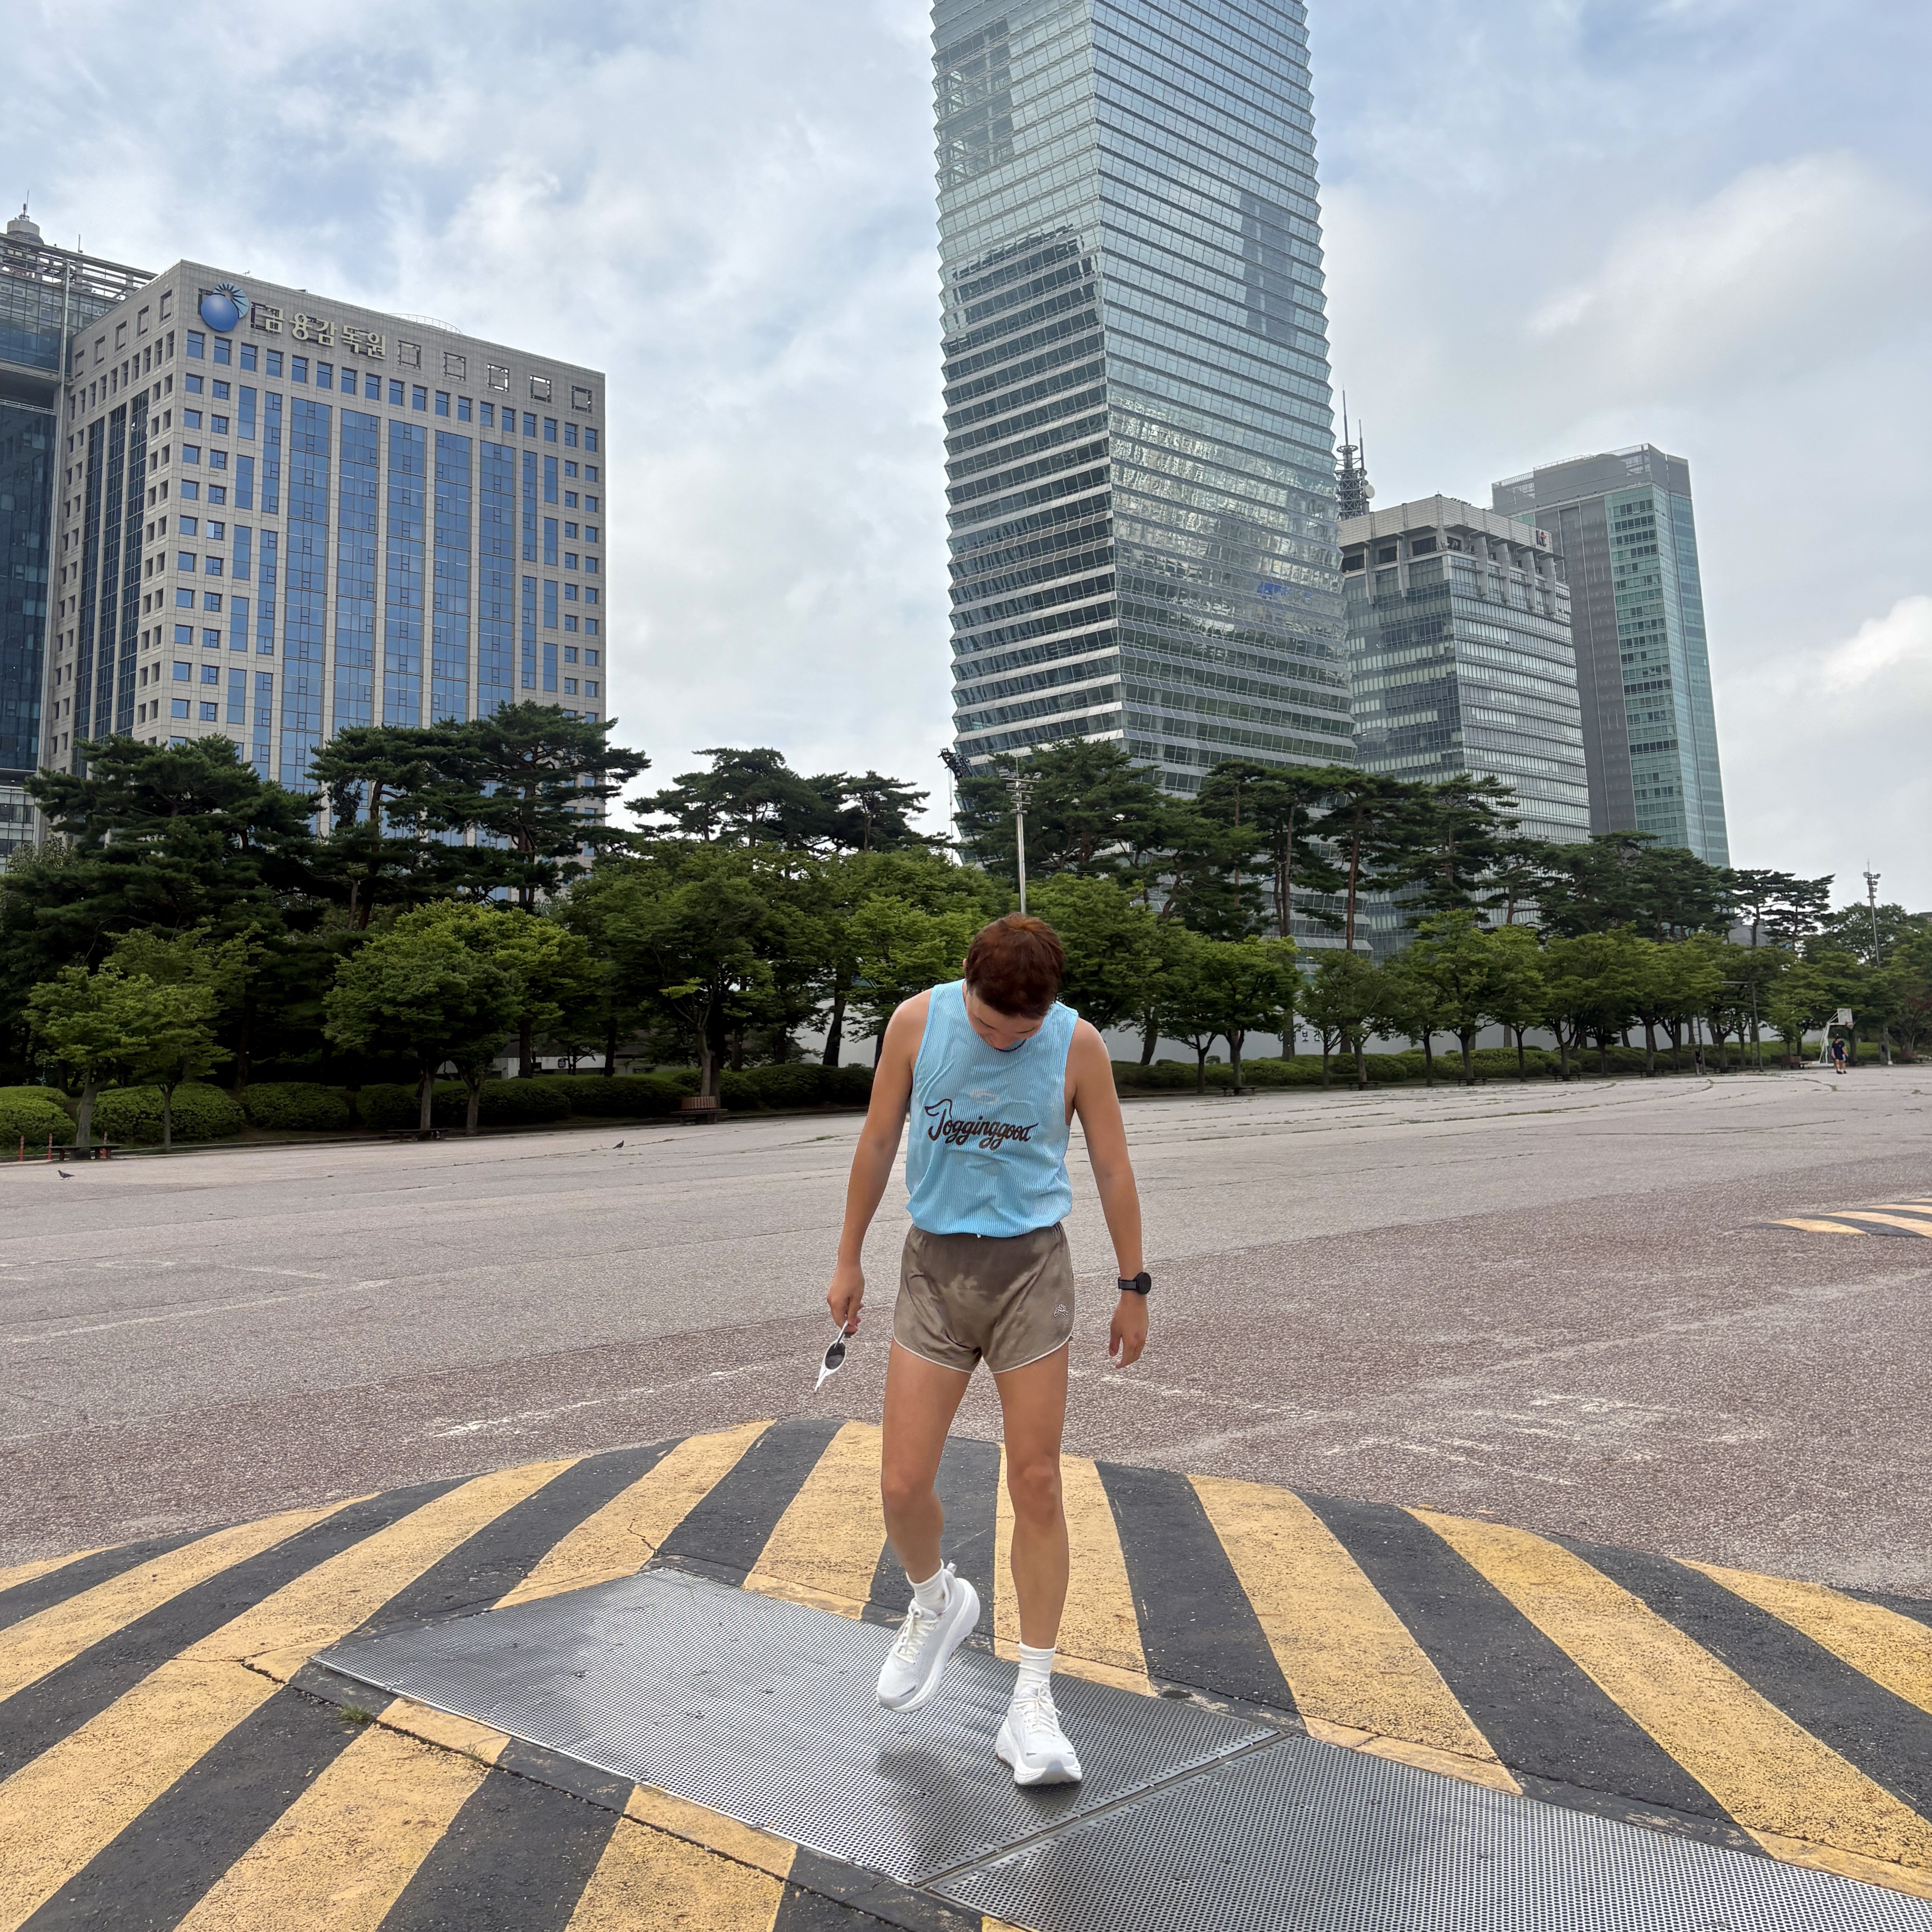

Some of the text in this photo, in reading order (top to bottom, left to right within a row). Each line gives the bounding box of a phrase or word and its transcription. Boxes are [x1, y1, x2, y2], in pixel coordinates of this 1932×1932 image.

[262, 305, 386, 360] 금융감독원
[1291, 1030, 1332, 1042] 보건
[924, 1099, 1038, 1150] Jogginggood
